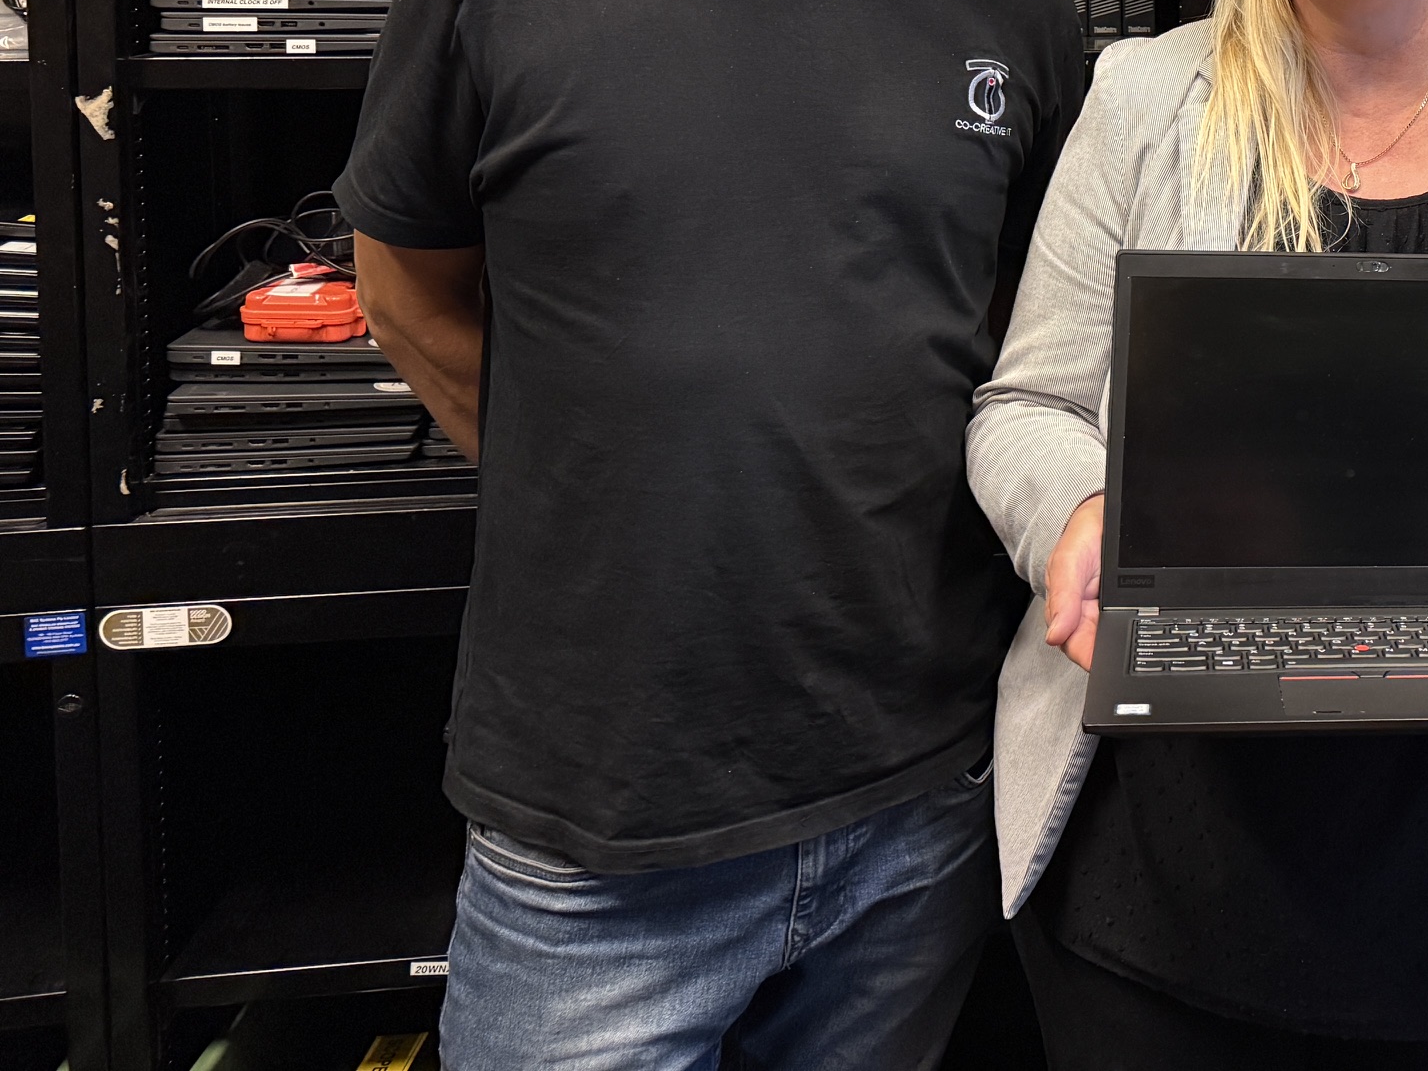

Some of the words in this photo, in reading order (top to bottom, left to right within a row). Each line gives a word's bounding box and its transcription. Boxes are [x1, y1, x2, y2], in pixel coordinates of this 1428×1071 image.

[955, 119, 1006, 136] CO-CREATIVE
[1120, 576, 1152, 585] Lenovo
[415, 965, 449, 974] 20WN
